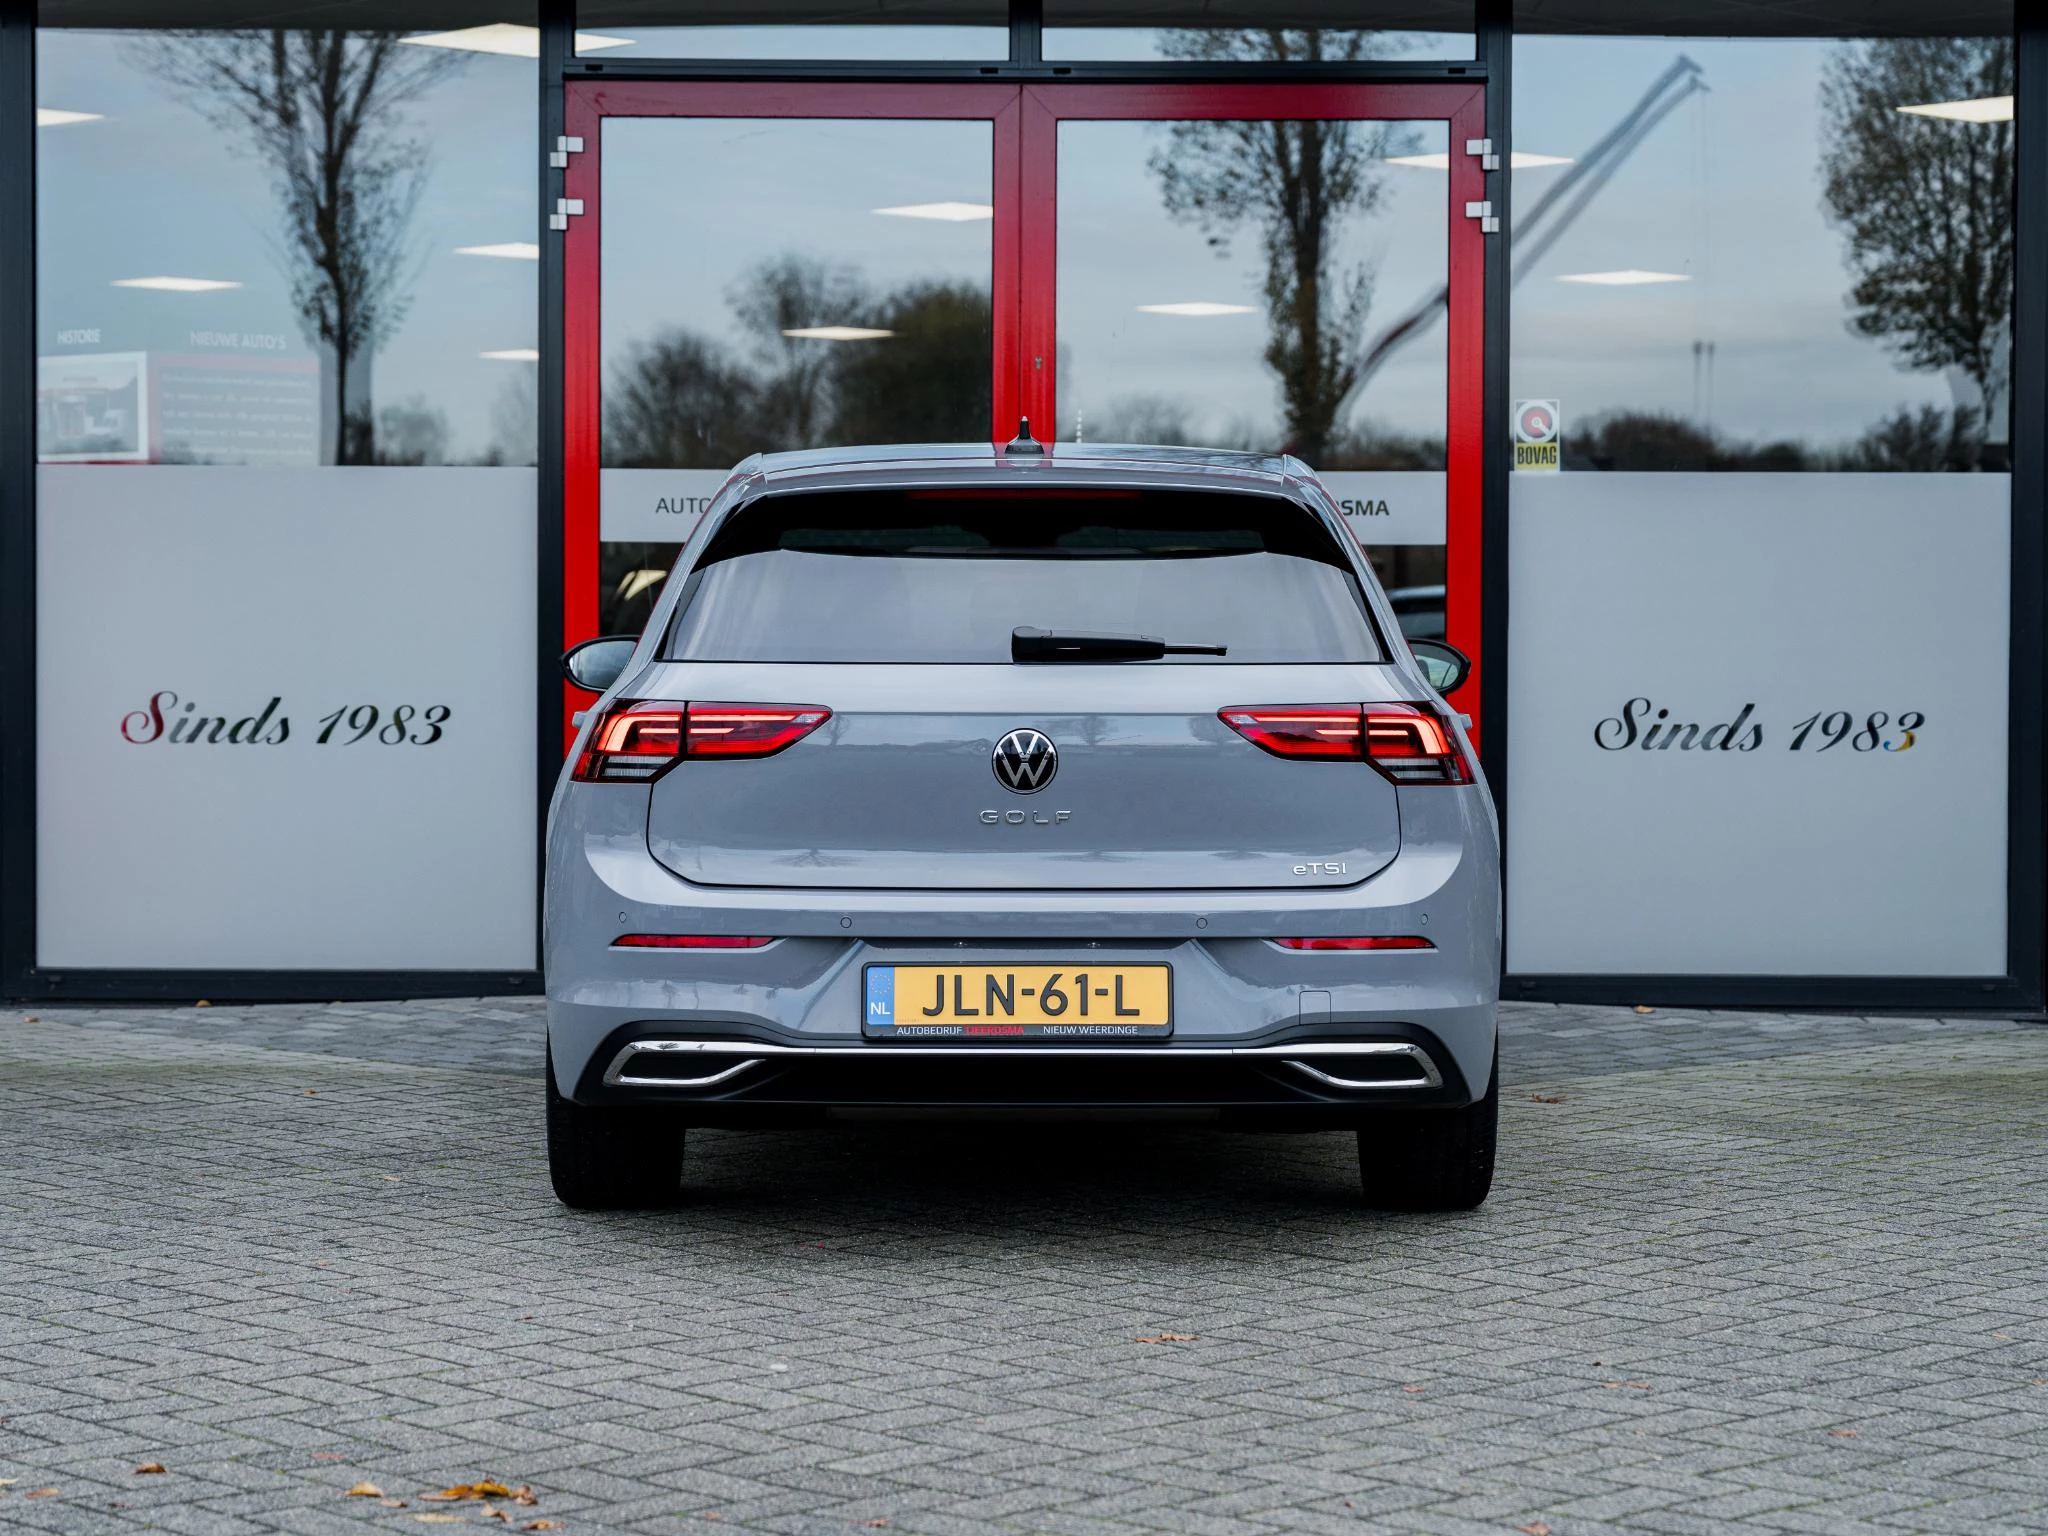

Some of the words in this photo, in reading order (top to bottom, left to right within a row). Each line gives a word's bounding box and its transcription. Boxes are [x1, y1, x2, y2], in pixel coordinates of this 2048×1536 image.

[57, 329, 101, 344] HISTORIE
[190, 331, 239, 347] NIEUWE
[241, 332, 287, 349] AUTO'S
[1517, 446, 1557, 465] BOVAG
[1337, 500, 1390, 516] SMA
[120, 691, 290, 745] Sinds
[315, 704, 452, 746] 1983
[1594, 697, 1764, 752] Sinds
[1789, 711, 1926, 753] 1983
[980, 809, 1072, 825] GOLF
[1293, 862, 1347, 875] eTSI
[922, 973, 1140, 1017] JLN-61-L
[870, 1002, 891, 1015] NL
[896, 1026, 962, 1036] AUTOBEDRIJF
[1043, 1025, 1077, 1035] NIEUW
[1078, 1025, 1138, 1035] WEERDINGE
